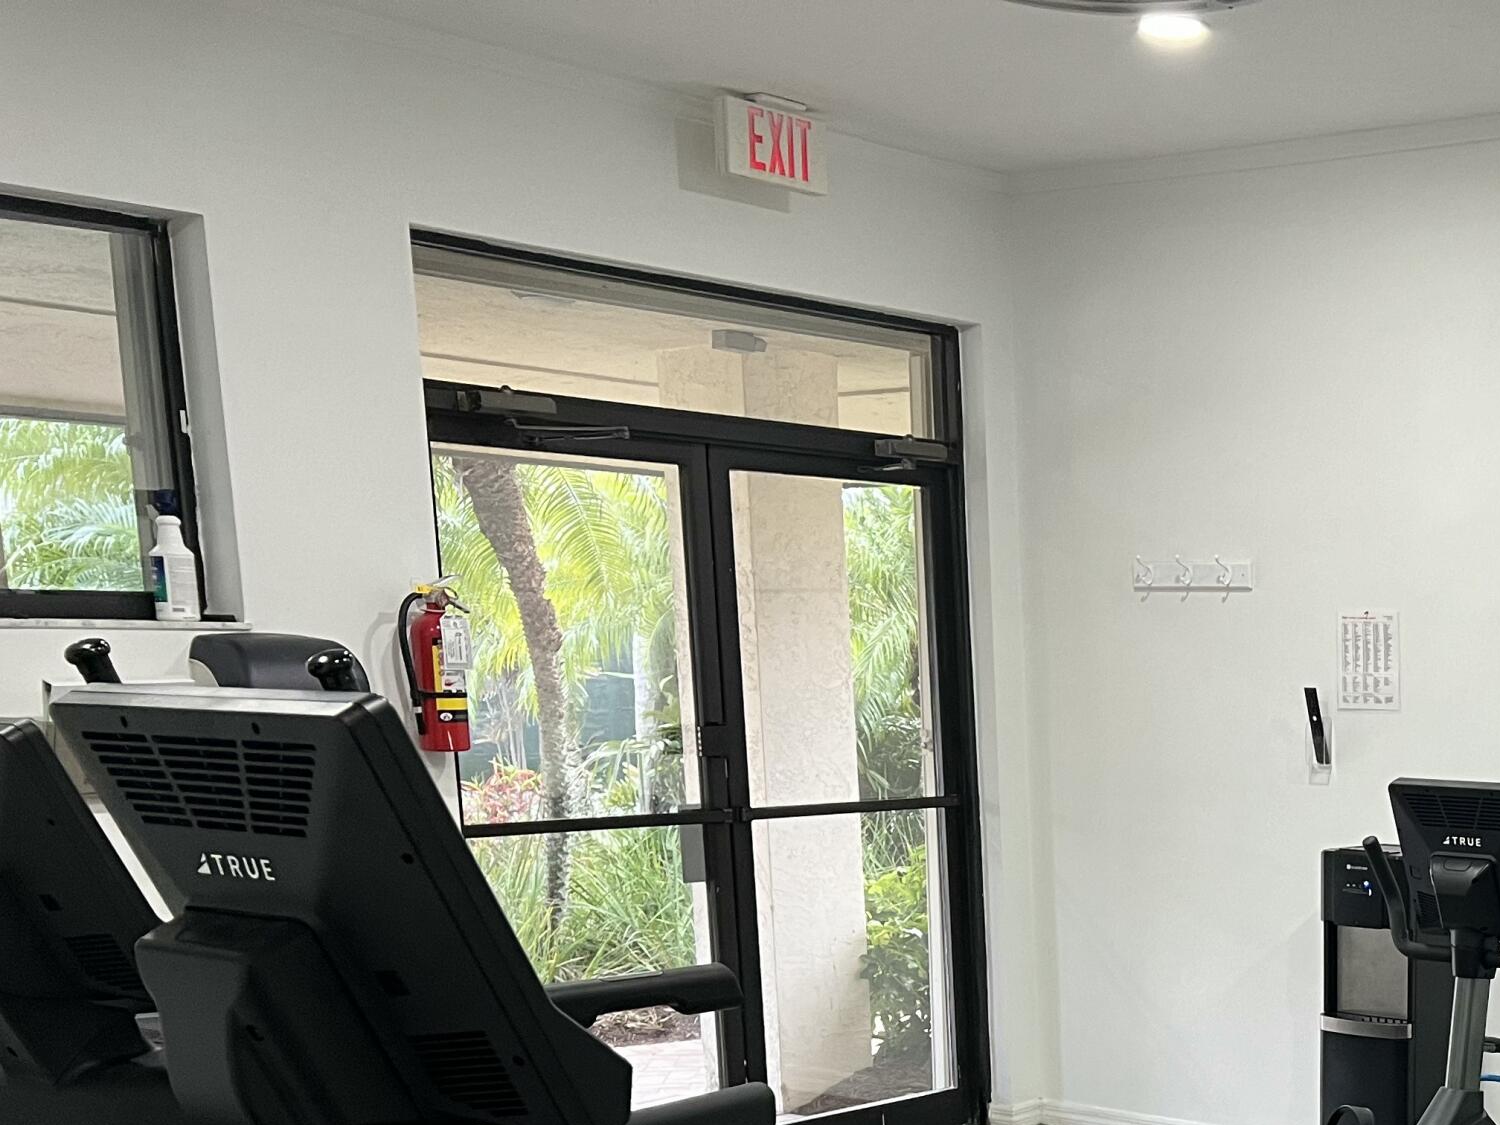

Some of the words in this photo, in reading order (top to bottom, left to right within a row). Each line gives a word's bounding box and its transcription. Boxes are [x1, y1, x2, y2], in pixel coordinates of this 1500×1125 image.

[747, 106, 812, 182] EXIT
[1451, 836, 1482, 847] TRUE
[210, 853, 276, 881] TRUE
